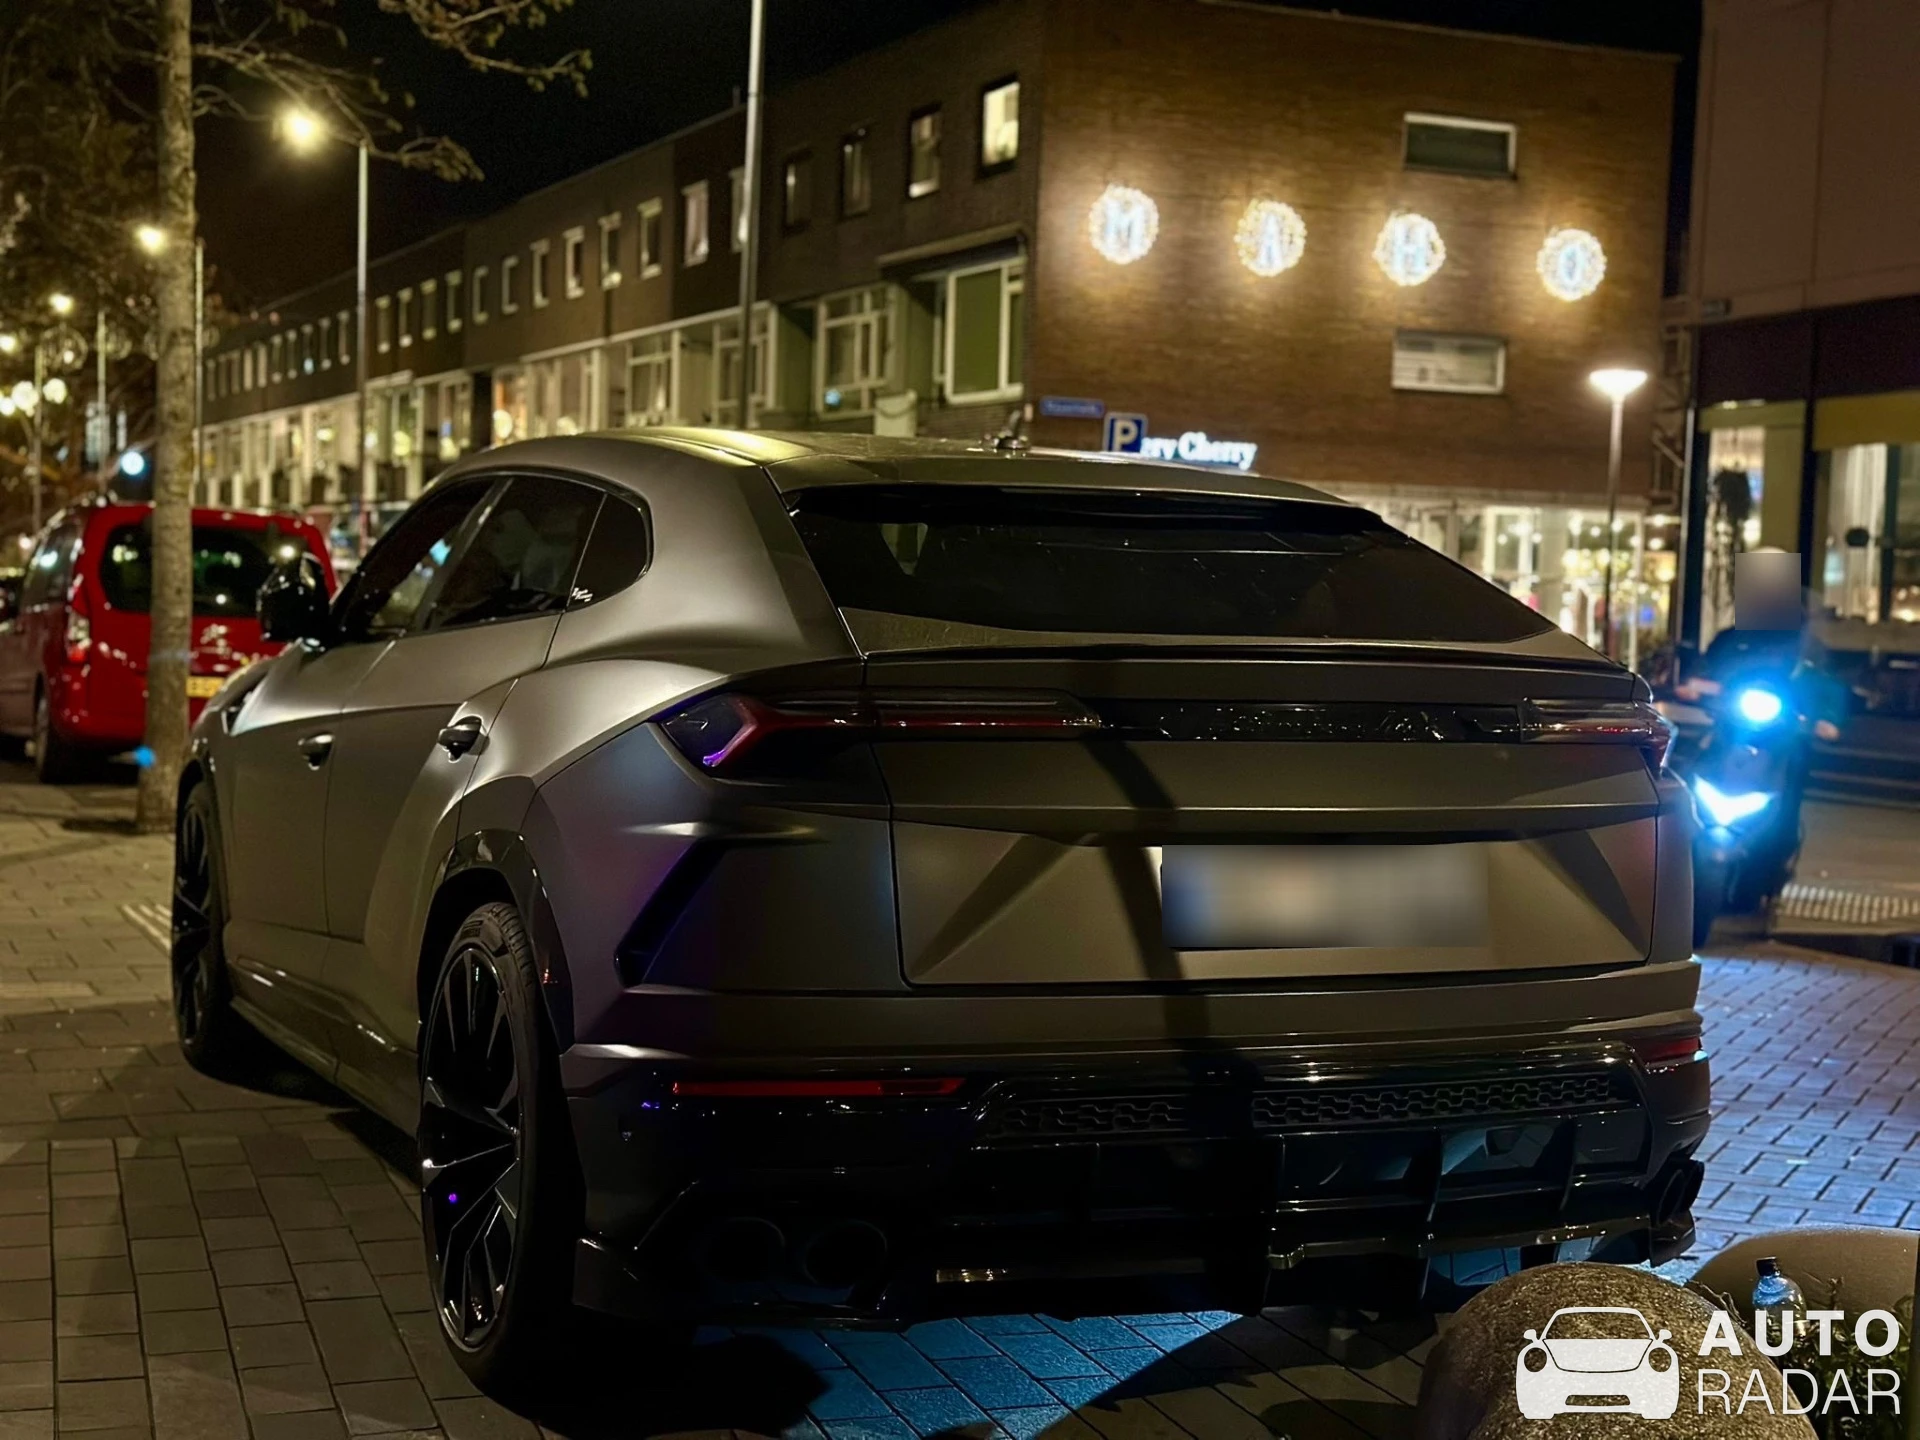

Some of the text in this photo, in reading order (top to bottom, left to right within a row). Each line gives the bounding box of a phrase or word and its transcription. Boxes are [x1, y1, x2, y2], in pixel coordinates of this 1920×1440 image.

[1106, 198, 1144, 250] M
[1112, 419, 1138, 451] P
[1178, 431, 1258, 471] Cherry
